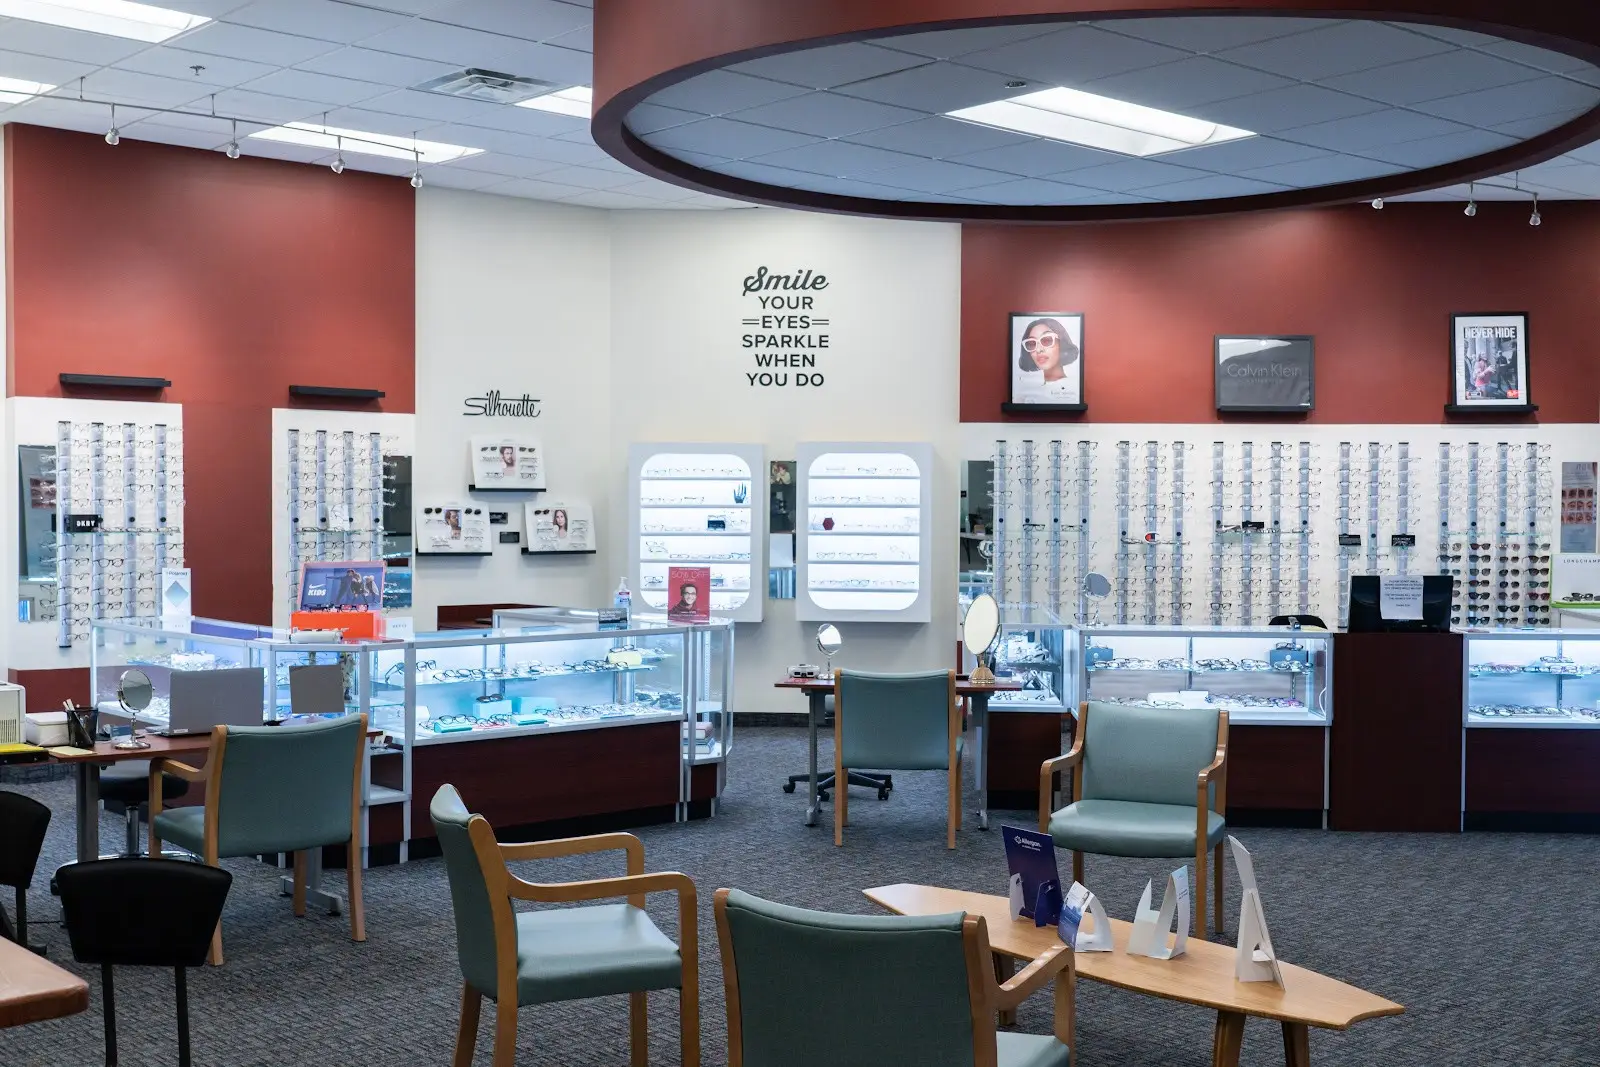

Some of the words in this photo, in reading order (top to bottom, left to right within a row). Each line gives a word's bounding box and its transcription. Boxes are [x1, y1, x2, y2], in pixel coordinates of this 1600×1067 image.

[742, 266, 829, 296] Smile
[758, 296, 814, 309] YOUR
[762, 315, 810, 328] EYES
[1465, 327, 1493, 339] NEVER
[1495, 327, 1516, 338] HIDE
[742, 334, 829, 348] SPARKLE
[755, 353, 815, 367] WHEN
[1227, 363, 1268, 377] Calvin
[1271, 363, 1303, 377] Klein
[746, 372, 788, 386] YOU
[796, 372, 824, 386] DO
[463, 390, 541, 417] Silhouette
